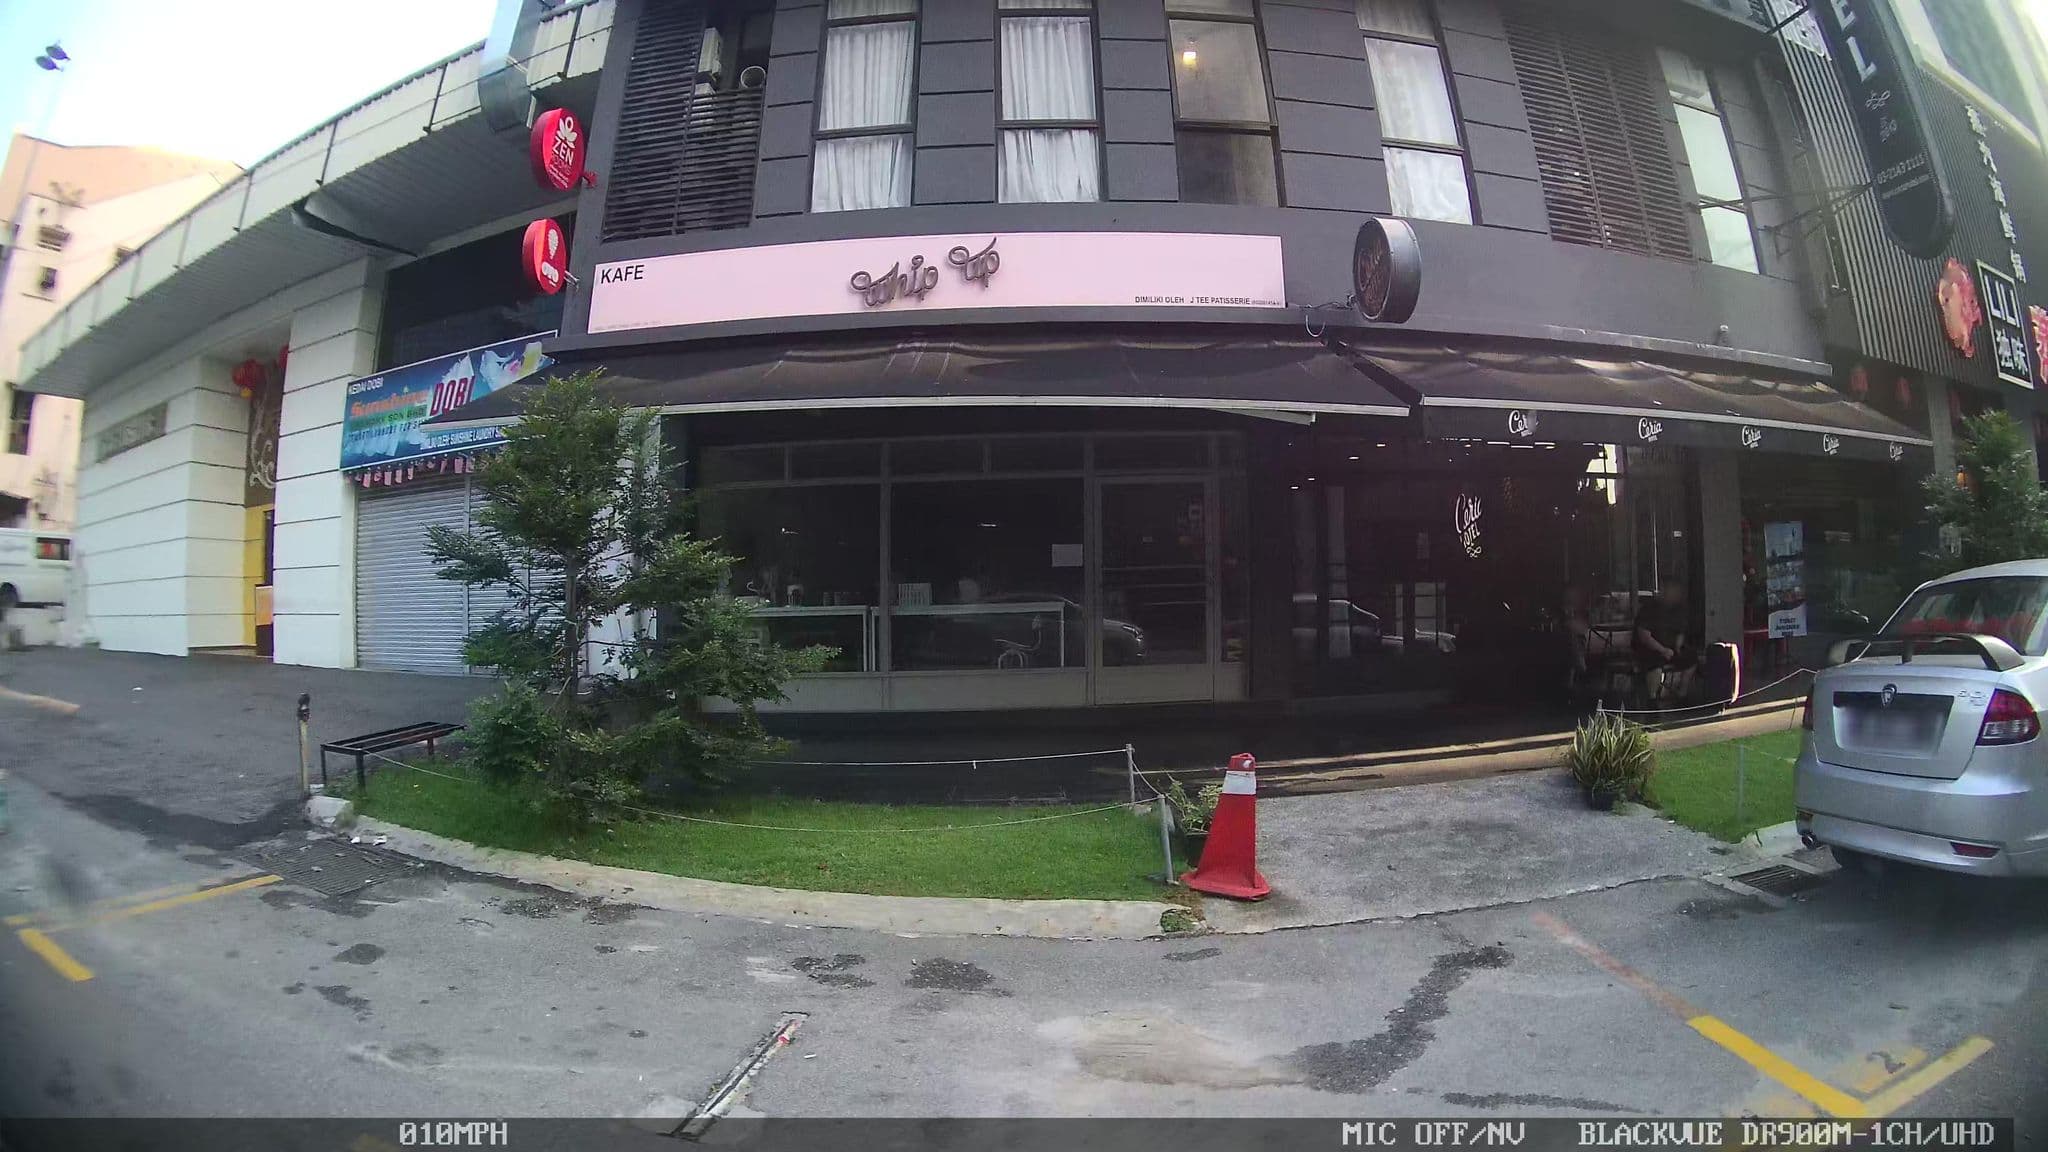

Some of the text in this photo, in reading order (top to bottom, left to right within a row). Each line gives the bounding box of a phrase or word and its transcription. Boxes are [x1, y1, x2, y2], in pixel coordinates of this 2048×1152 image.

[552, 135, 574, 166] ZEN
[600, 264, 645, 284] KAFE
[1134, 295, 1164, 304] DIMILIKI
[1164, 296, 1185, 304] OLEH
[1190, 296, 1195, 304] J
[1195, 296, 1210, 304] TEE
[1210, 296, 1251, 306] PATISSERIE
[430, 375, 476, 417] DOBI
[1638, 417, 1663, 440] Ceria
[1741, 425, 1762, 446] Ceria
